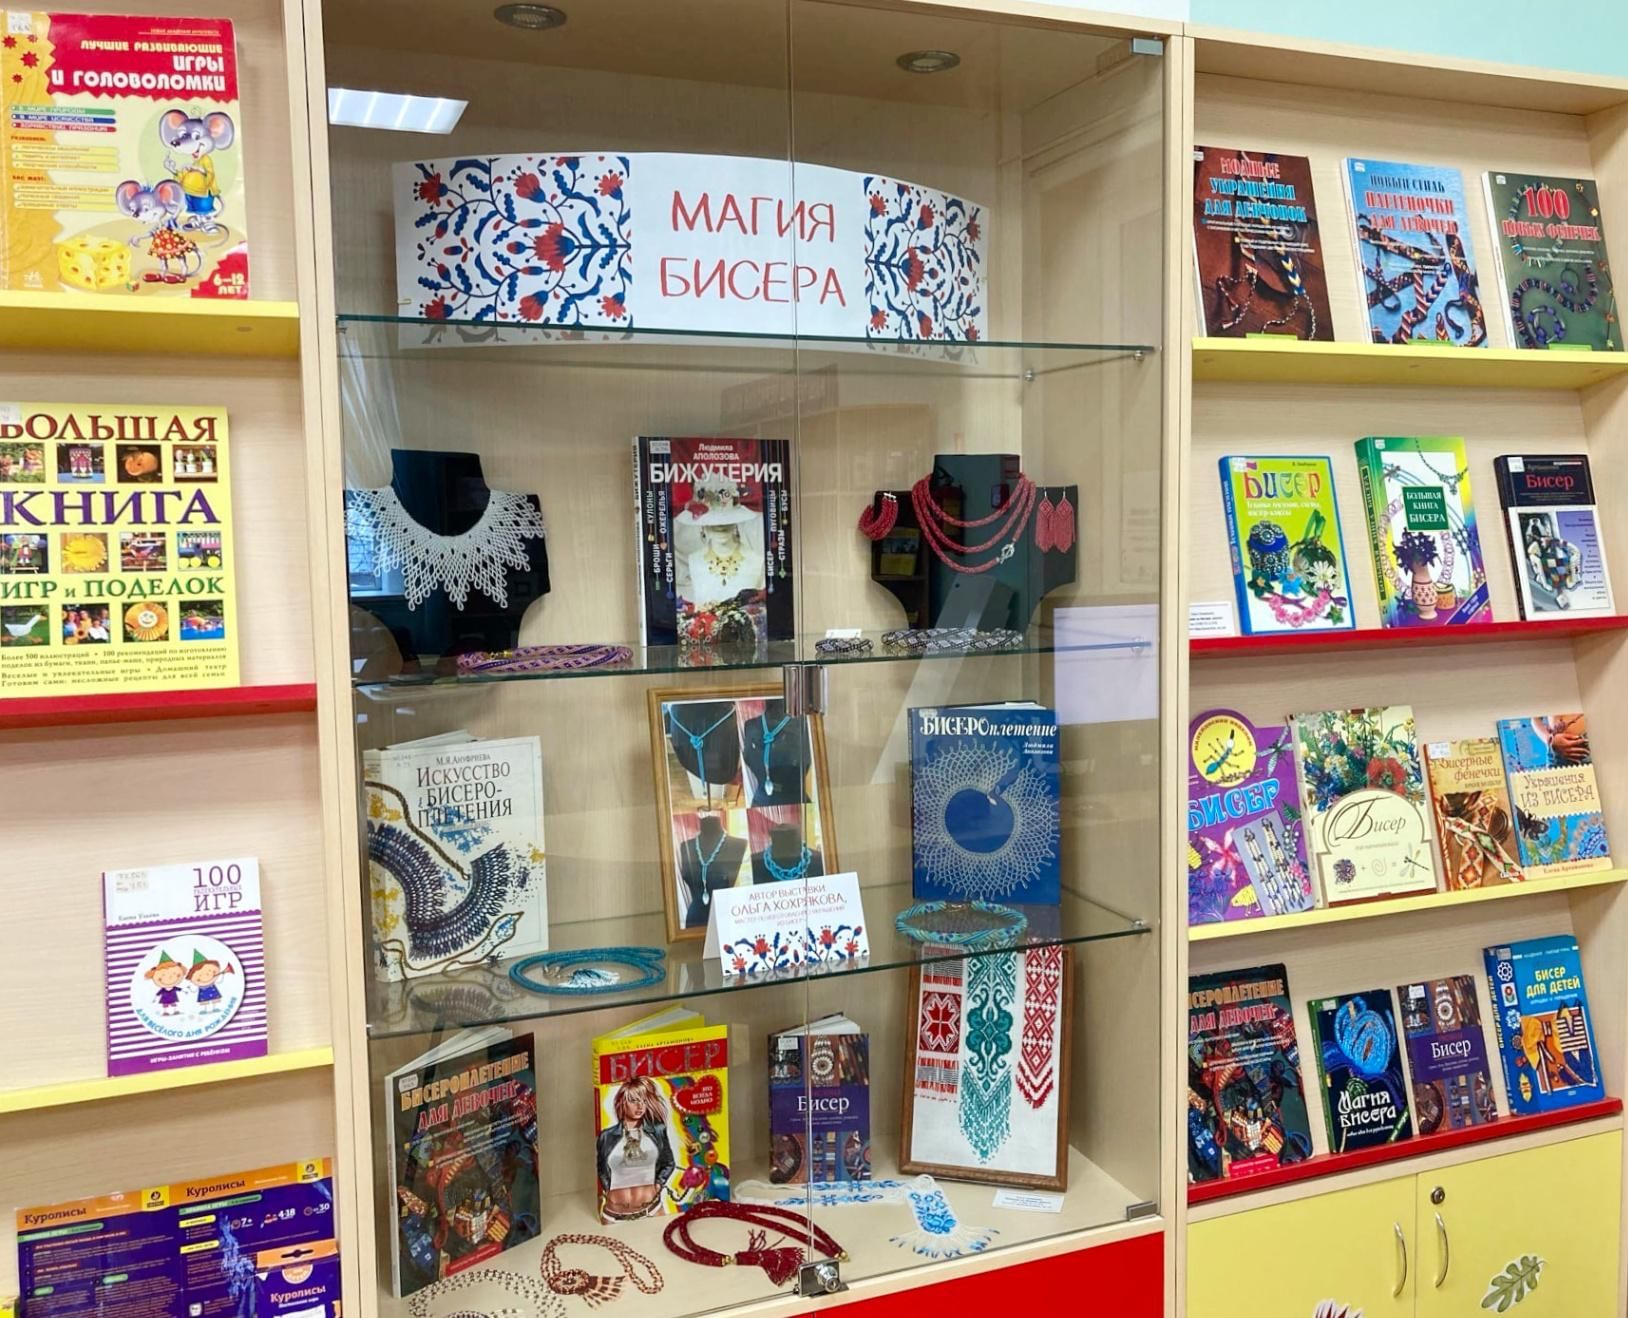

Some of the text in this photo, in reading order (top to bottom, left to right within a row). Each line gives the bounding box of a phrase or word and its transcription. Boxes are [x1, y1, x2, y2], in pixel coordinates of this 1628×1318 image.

[81, 40, 129, 51] ЛУЧШИЕ
[173, 55, 225, 72] ИГРЫ
[51, 69, 226, 91] И ГОЛОВОЛОМКИ
[1209, 177, 1296, 201] УКРАШЕНИЯ
[1204, 198, 1233, 216] ДЛЯ
[1523, 187, 1570, 220] 100
[671, 190, 835, 242] МАГИЯ
[218, 285, 242, 295] ЛЕТ
[660, 257, 847, 307] БИСЕРА
[693, 453, 740, 461] АПОЛОЗОВА
[698, 443, 734, 452] Людмила
[650, 463, 783, 483] БИЖУТЕРИЯ
[1525, 474, 1574, 490] Бисер
[1406, 491, 1442, 500] БОЛЬШАЯ
[1412, 501, 1439, 510] КНИГА
[0, 488, 221, 526] КНИГА
[658, 490, 667, 534] ОЖЕРЕЛЬЯ
[1409, 513, 1446, 523] БИСЕРА
[653, 544, 661, 574] БРОШИ
[666, 552, 674, 583] СЕРЬГИ
[1, 577, 57, 600] ИГР
[84, 577, 225, 599] ПОДЕЛОК
[416, 762, 510, 787] ИСКУССТВО
[1524, 772, 1585, 790] Украшения
[427, 781, 503, 807] БИСЕРО-
[1188, 778, 1280, 831] БИСЕР
[1520, 785, 1596, 807] ИЗ БИСЕРА
[418, 798, 512, 828] ПЛЕТЕНИЯ
[1328, 796, 1406, 847] Бисер
[193, 864, 242, 888] 100
[194, 891, 243, 912] ИГР
[749, 890, 777, 902] АВТОР
[731, 902, 771, 917] ОЛЬГА
[1535, 966, 1566, 982] БИСЕР
[1188, 979, 1285, 1009] СЕРОПЛЕТЕНИЕ
[1526, 982, 1547, 999] ДЛЯ
[1549, 975, 1581, 995] ДЕТЕЙ
[1190, 1003, 1278, 1034] ДЛЯ ДЕВОЧЕК
[1431, 1040, 1471, 1058] Бисер
[610, 1043, 721, 1083] БИСЕР
[401, 1051, 529, 1112] БИСЕРОПЛЕТЕНИЕ
[417, 1079, 520, 1132] ДЛЯ ДЕВОЧЕК
[797, 1095, 850, 1115] Бисер
[1338, 1090, 1391, 1114] Магия
[186, 1180, 246, 1197] Куролисы
[24, 1208, 87, 1224] Куролисы
[270, 1286, 326, 1303] Куролисы
